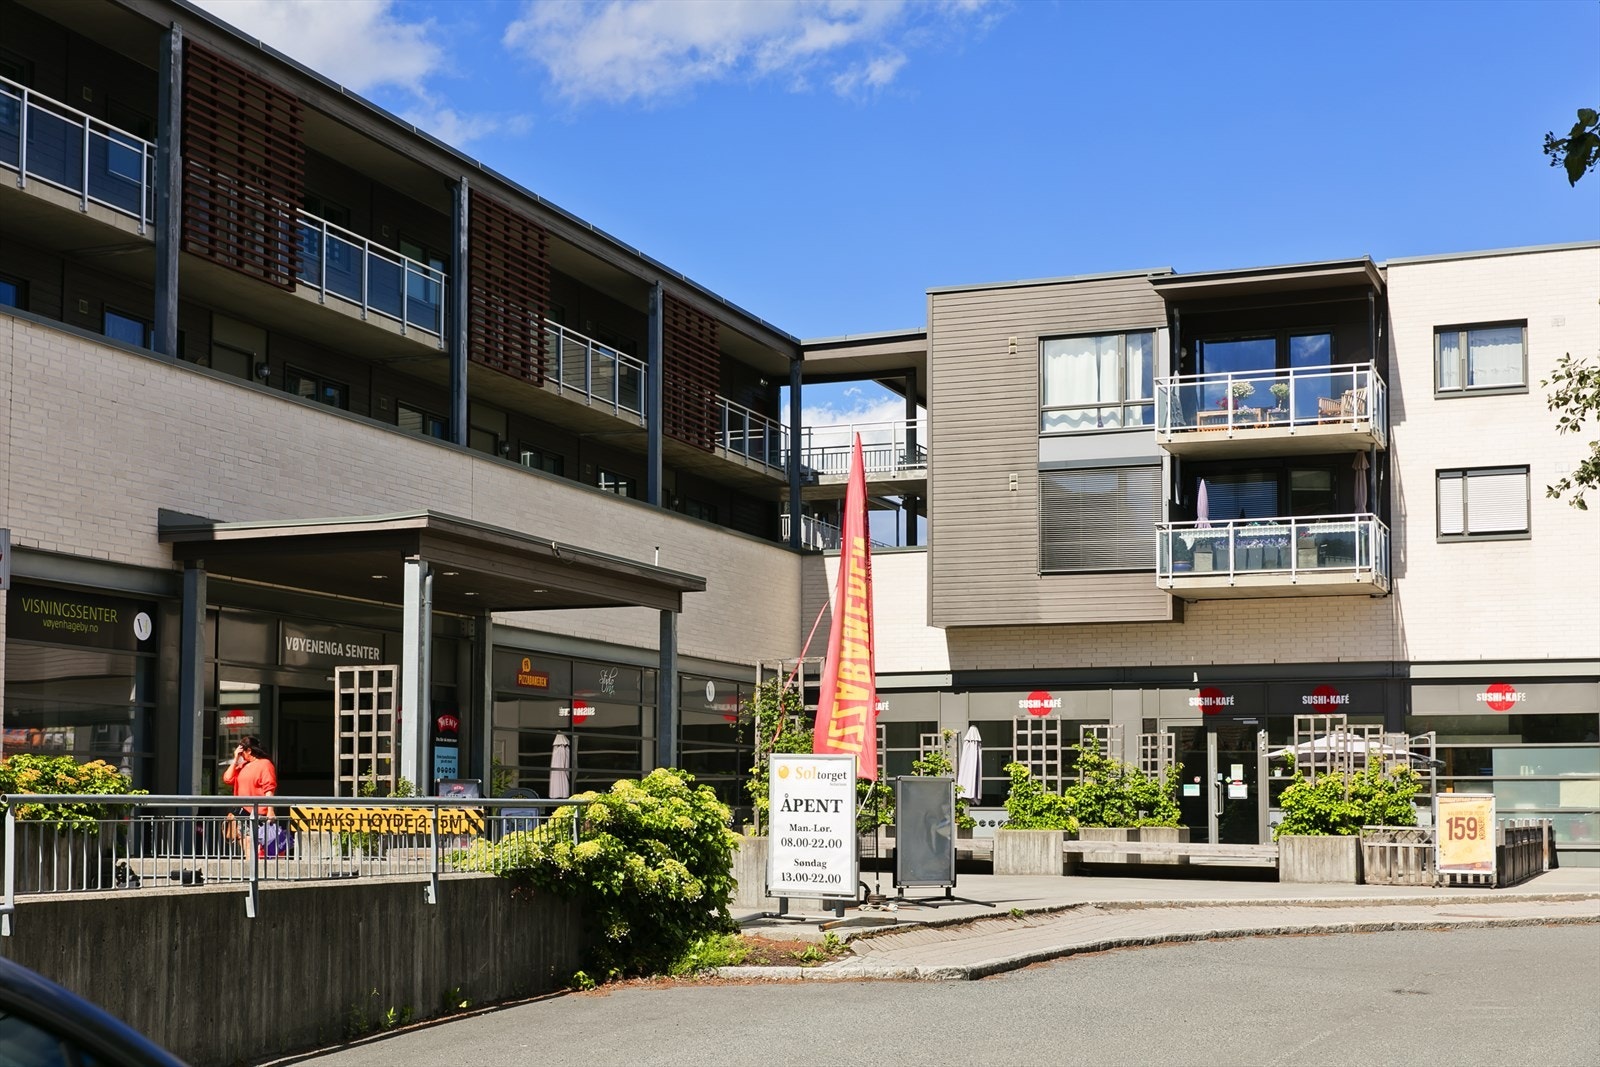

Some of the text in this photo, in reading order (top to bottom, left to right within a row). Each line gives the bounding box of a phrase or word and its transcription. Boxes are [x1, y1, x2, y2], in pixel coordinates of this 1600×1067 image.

[21, 597, 118, 623] VISNINGSSENTER
[42, 618, 99, 634] vøyenhageby.no
[285, 636, 380, 660] VØYENENGA SENTER
[438, 717, 458, 729] MENY
[795, 765, 847, 781] Soltorget
[780, 792, 843, 813] ÅPENT
[311, 812, 355, 828] MAKS
[360, 812, 414, 829] HØYDE
[1446, 816, 1478, 841] 159
[780, 837, 843, 849] 08.00-22.00
[793, 858, 828, 870] Søndag
[781, 871, 842, 884] 13.00-22.00
